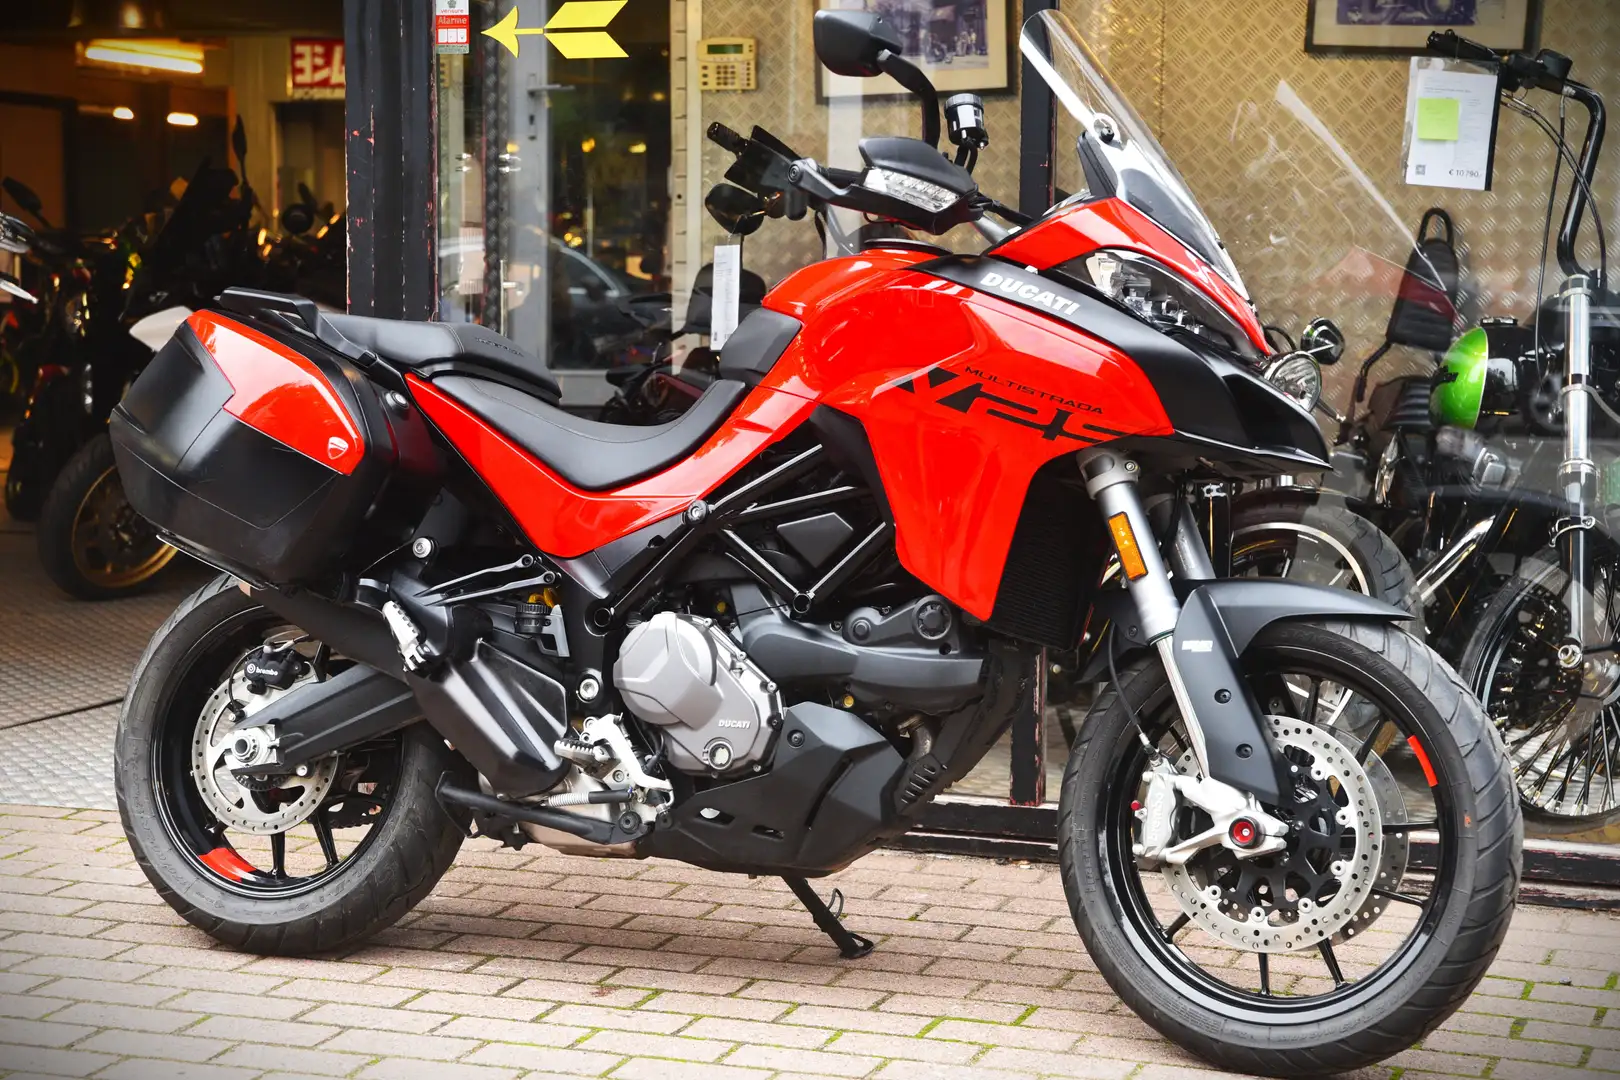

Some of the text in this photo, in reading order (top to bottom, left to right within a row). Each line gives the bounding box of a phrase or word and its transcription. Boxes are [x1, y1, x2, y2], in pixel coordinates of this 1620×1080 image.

[438, 16, 467, 25] Alarme
[980, 272, 1081, 316] DUCATI
[965, 366, 1103, 414] MULTISTRADA
[256, 666, 278, 676] brembo
[718, 719, 751, 729] DUCATI
